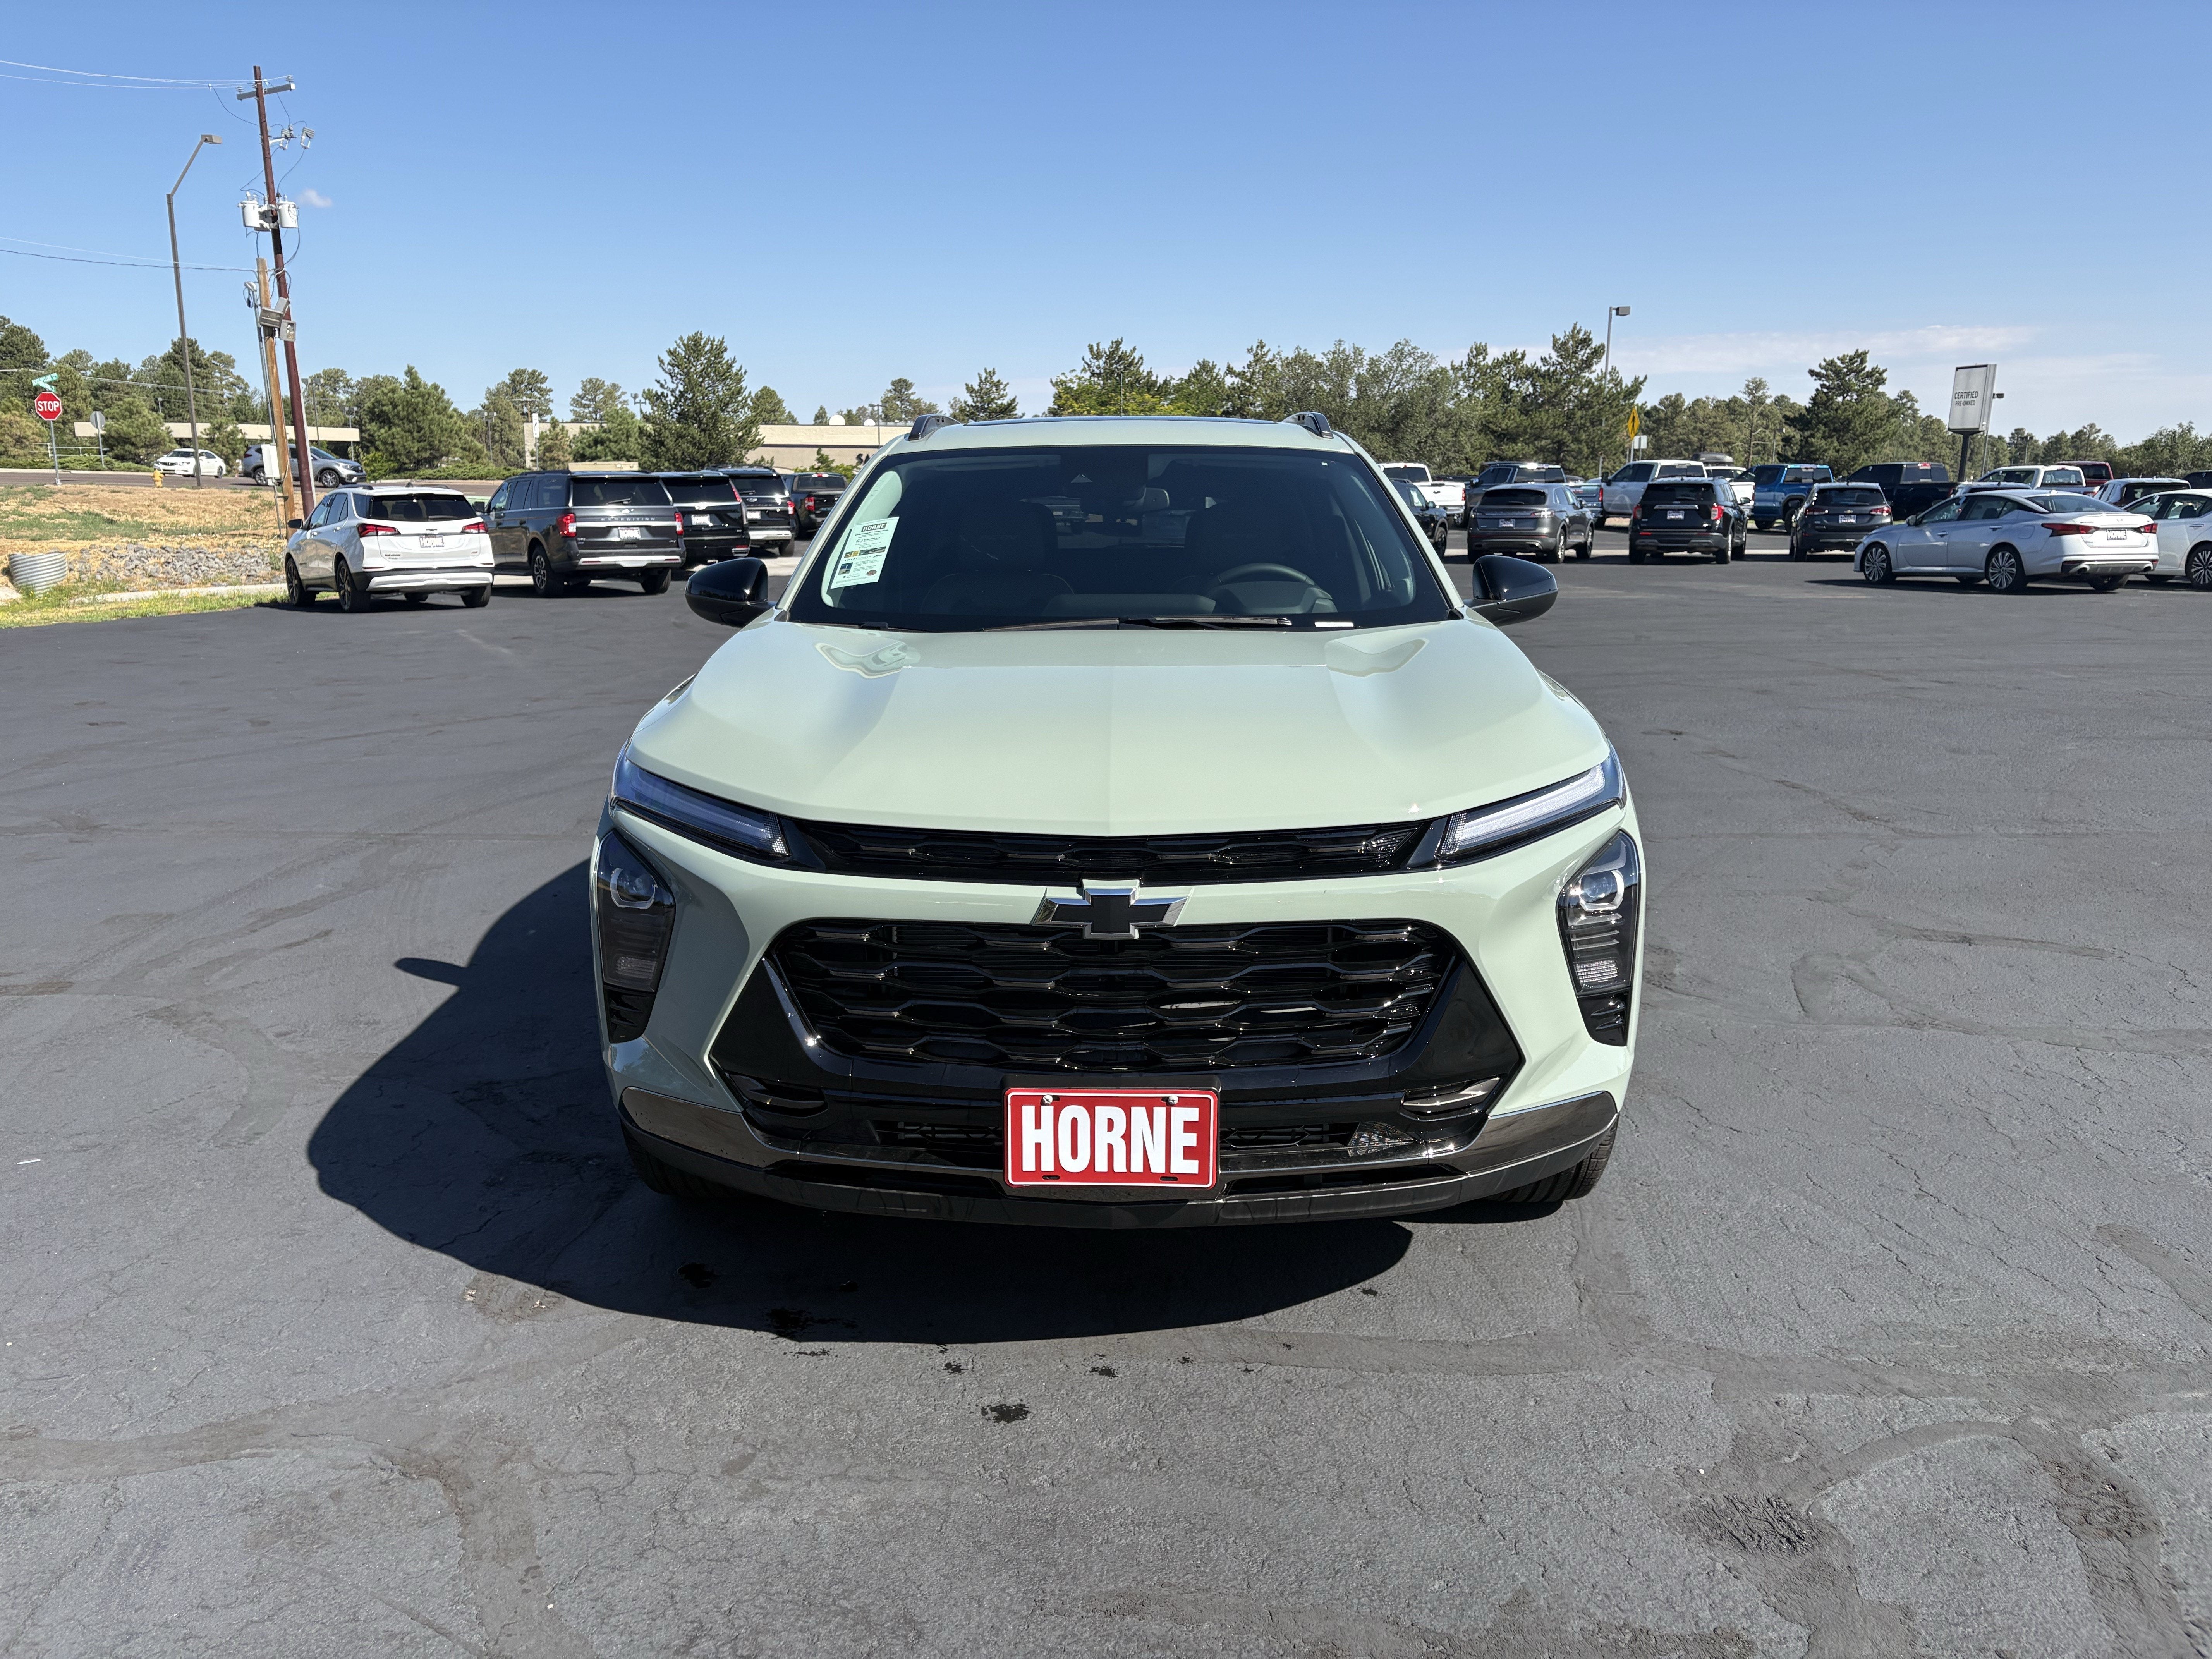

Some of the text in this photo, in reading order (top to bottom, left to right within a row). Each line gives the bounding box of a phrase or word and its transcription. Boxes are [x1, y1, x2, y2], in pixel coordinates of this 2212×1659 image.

[1954, 391, 1978, 399] CERTIFIED
[38, 401, 59, 411] STOP
[1022, 1105, 1199, 1174] HORNE
